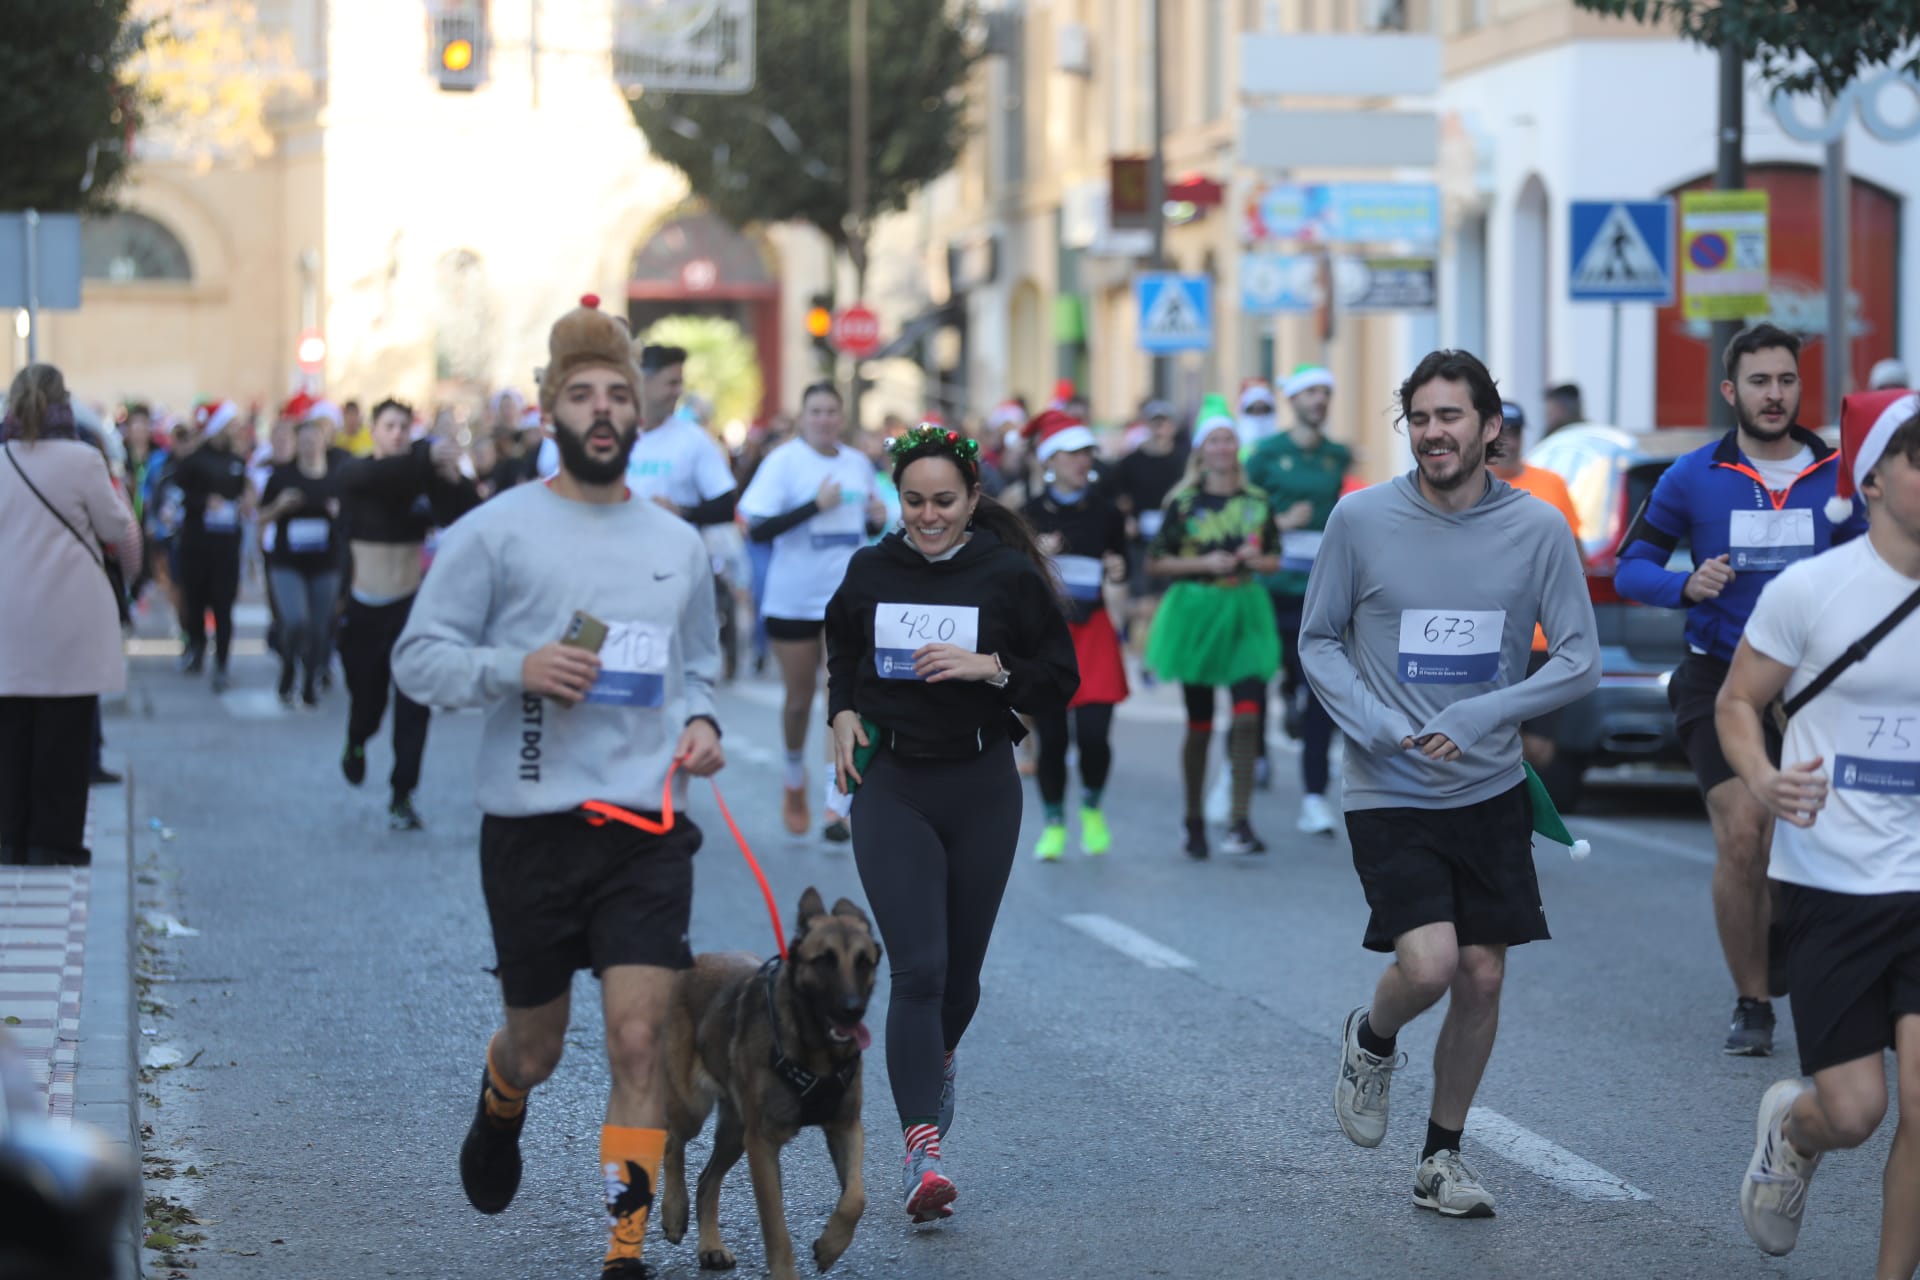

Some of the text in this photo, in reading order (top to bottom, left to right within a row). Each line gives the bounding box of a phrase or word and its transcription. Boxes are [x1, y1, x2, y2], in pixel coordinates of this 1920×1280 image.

[899, 611, 955, 641] 420
[1424, 615, 1475, 648] 673
[519, 691, 543, 783] UST DO IT
[1859, 715, 1916, 751] 75
